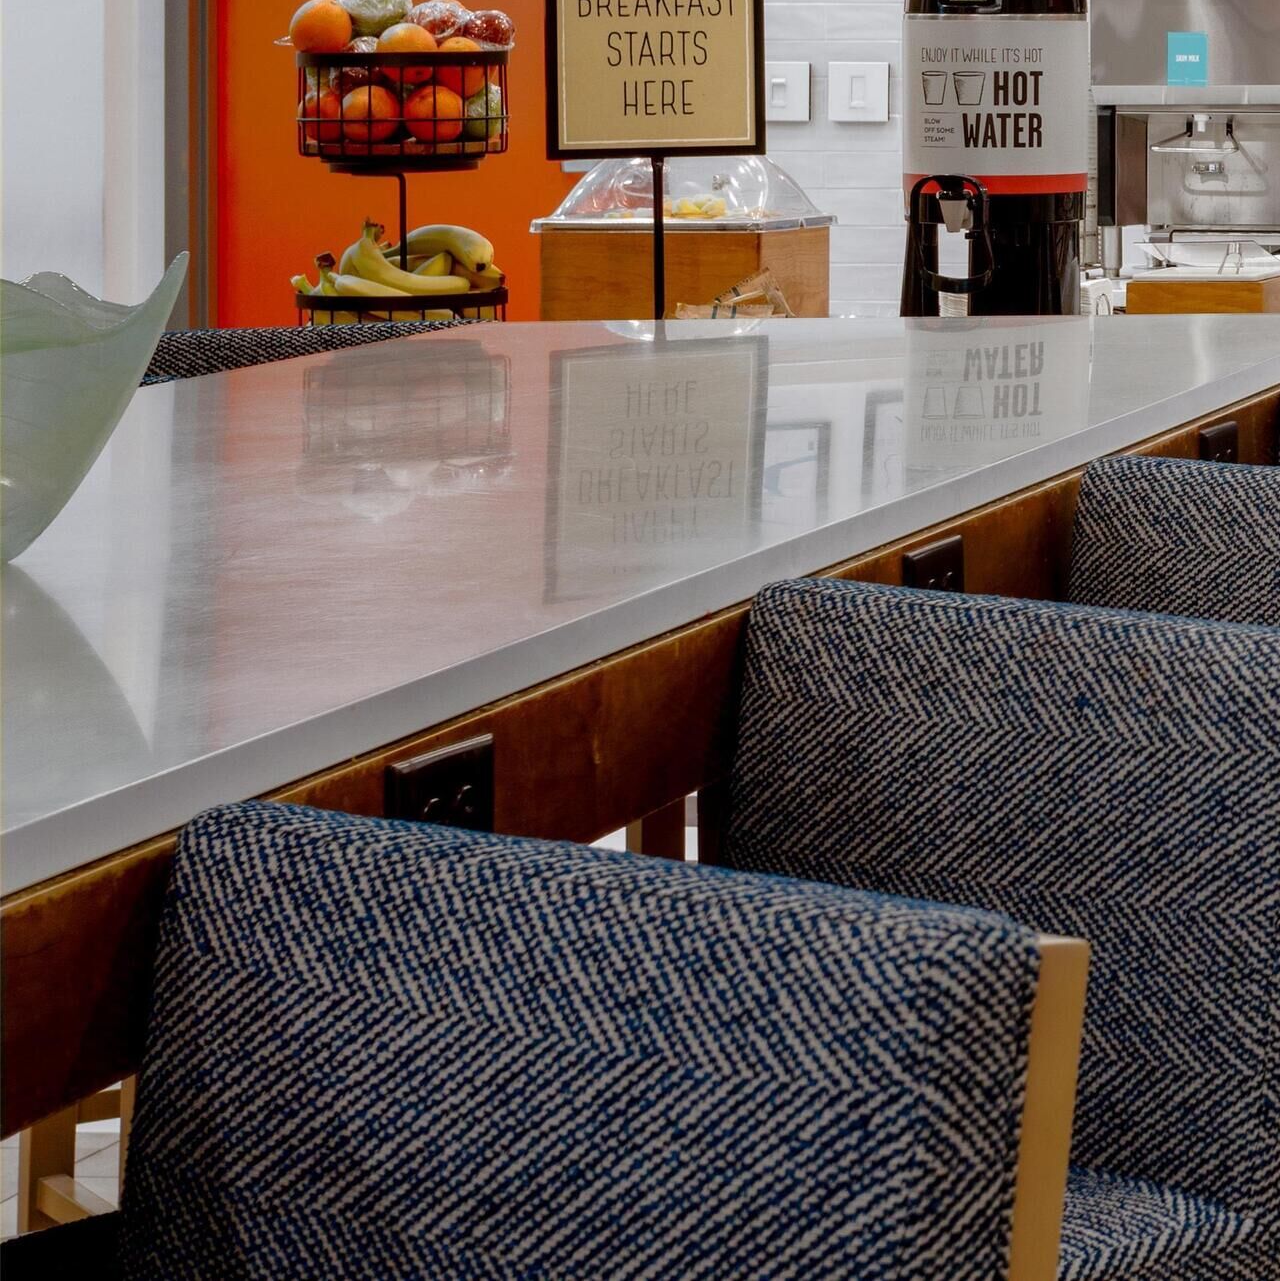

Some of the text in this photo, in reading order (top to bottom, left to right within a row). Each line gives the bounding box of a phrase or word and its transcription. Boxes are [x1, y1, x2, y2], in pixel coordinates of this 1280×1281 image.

[606, 30, 709, 67] STARTS
[921, 47, 1044, 63] ENJOY IT WHILE IT'S HOT
[623, 80, 695, 116] HERE
[993, 71, 1043, 106] HOT
[962, 113, 1043, 148] WATER
